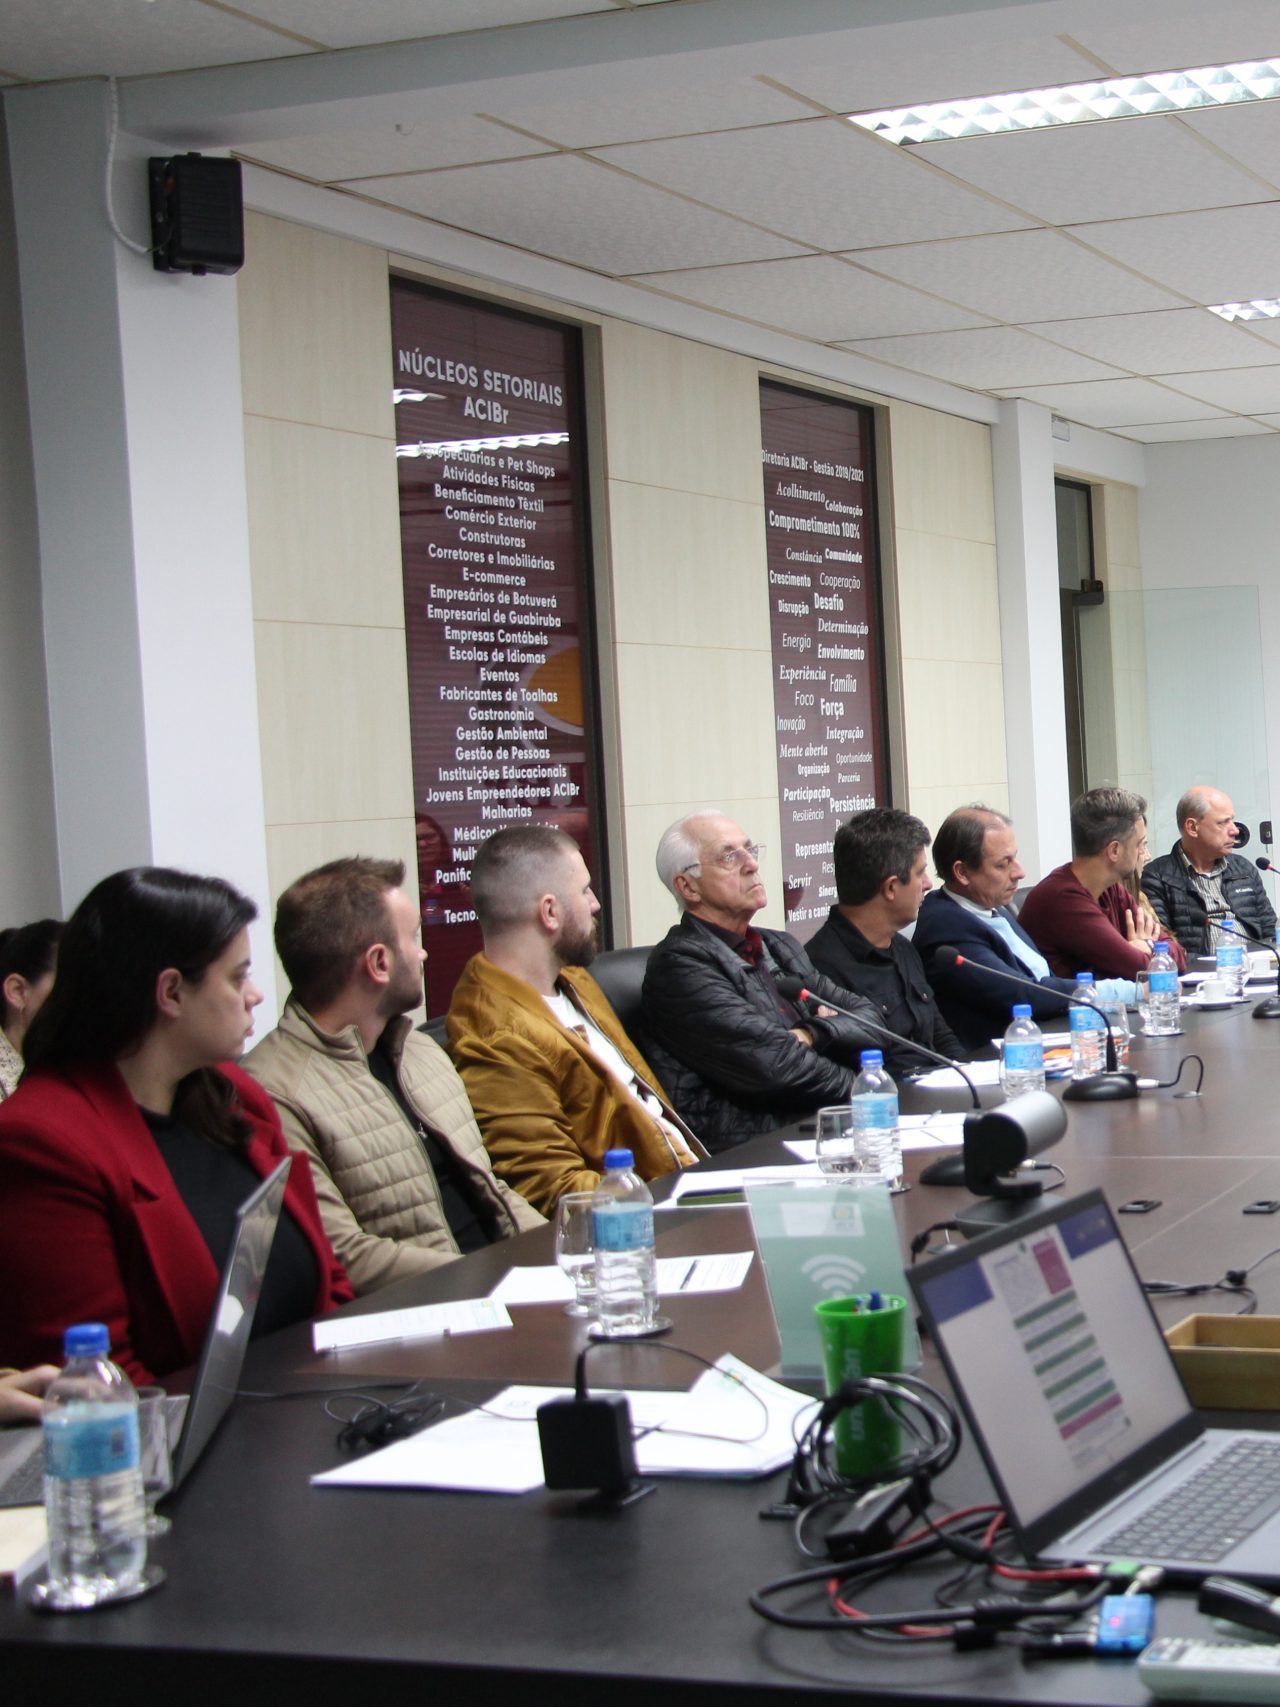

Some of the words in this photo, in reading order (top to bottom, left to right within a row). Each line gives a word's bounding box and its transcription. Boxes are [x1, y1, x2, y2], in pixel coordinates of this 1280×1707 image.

[399, 348, 478, 388] NÚCLEOS
[483, 369, 563, 407] SETORIAIS
[464, 396, 509, 425] ACIBr
[498, 458, 505, 468] e
[507, 457, 524, 472] Pet
[526, 460, 556, 478] Shops
[760, 449, 790, 468] Diretoria
[791, 455, 808, 471] ACIBr
[813, 460, 835, 476] Gestão
[835, 465, 864, 482] 2019/2021
[443, 465, 499, 487] Atividades
[501, 475, 536, 493] Físicas
[434, 484, 516, 509] Beneficiamento
[517, 494, 544, 513] Têxtil
[776, 481, 825, 503] Acolhimento
[445, 505, 496, 525] Comércio
[498, 512, 537, 531] Exterior
[825, 500, 863, 517] Colaboração
[769, 510, 841, 536] Comprometimento
[841, 522, 860, 539] 100%
[459, 527, 526, 549] Construtoras
[428, 544, 485, 564] Corretores
[488, 554, 494, 564] e
[497, 552, 555, 571] Imobiliárias
[786, 547, 823, 564] Constância
[825, 548, 863, 564] Comunidade
[462, 567, 526, 587] E-commerce
[769, 569, 811, 588] Crescimento
[819, 572, 861, 592] Cooperação
[430, 584, 495, 606] Empresários
[497, 588, 511, 605] de
[513, 590, 558, 609] Botuverá
[814, 592, 844, 611] Desafio
[427, 604, 491, 625] Empresarial
[493, 608, 507, 624] de
[509, 610, 562, 629] Guabiruba
[778, 599, 809, 618] Disrupção
[444, 625, 496, 646] Empresas
[497, 628, 549, 646] Contábeis
[817, 618, 869, 638] Determinação
[449, 645, 489, 663] Escolas
[491, 645, 505, 662] de
[506, 647, 547, 665] Idiomas
[817, 644, 865, 661] Envolvimento
[479, 667, 520, 683] Eventos
[780, 665, 826, 684] Experiência
[829, 673, 857, 693] Família
[439, 685, 503, 702] Fabricantes
[504, 685, 519, 702] de
[520, 687, 559, 704] Toalhas
[795, 690, 815, 706] Foco
[468, 706, 535, 722] Gastronomia
[820, 697, 844, 720] Força
[456, 726, 494, 742] Gestão
[496, 726, 548, 741] Ambiental
[777, 715, 806, 734] Inovação
[826, 725, 864, 743] Integração
[455, 746, 494, 762] Gestão
[496, 744, 510, 761] de
[511, 746, 551, 761] Pessoas
[779, 744, 803, 758] Mente
[804, 745, 828, 757] aberta
[836, 751, 873, 765] Oportunidade
[438, 765, 501, 784] Instituições
[502, 763, 568, 780] Educacionais
[798, 763, 830, 777] Organização
[837, 772, 861, 784] Parceria
[426, 787, 464, 805] Jovens
[466, 783, 551, 803] Empreendedores
[553, 782, 581, 797] ACIBr
[783, 785, 831, 802] Participação
[481, 803, 533, 821] Malharias
[829, 795, 875, 813] Persistência
[795, 840, 835, 859] Representa
[788, 873, 812, 889] Servir
[444, 909, 479, 924] Tecno
[788, 906, 807, 922] Vestir
